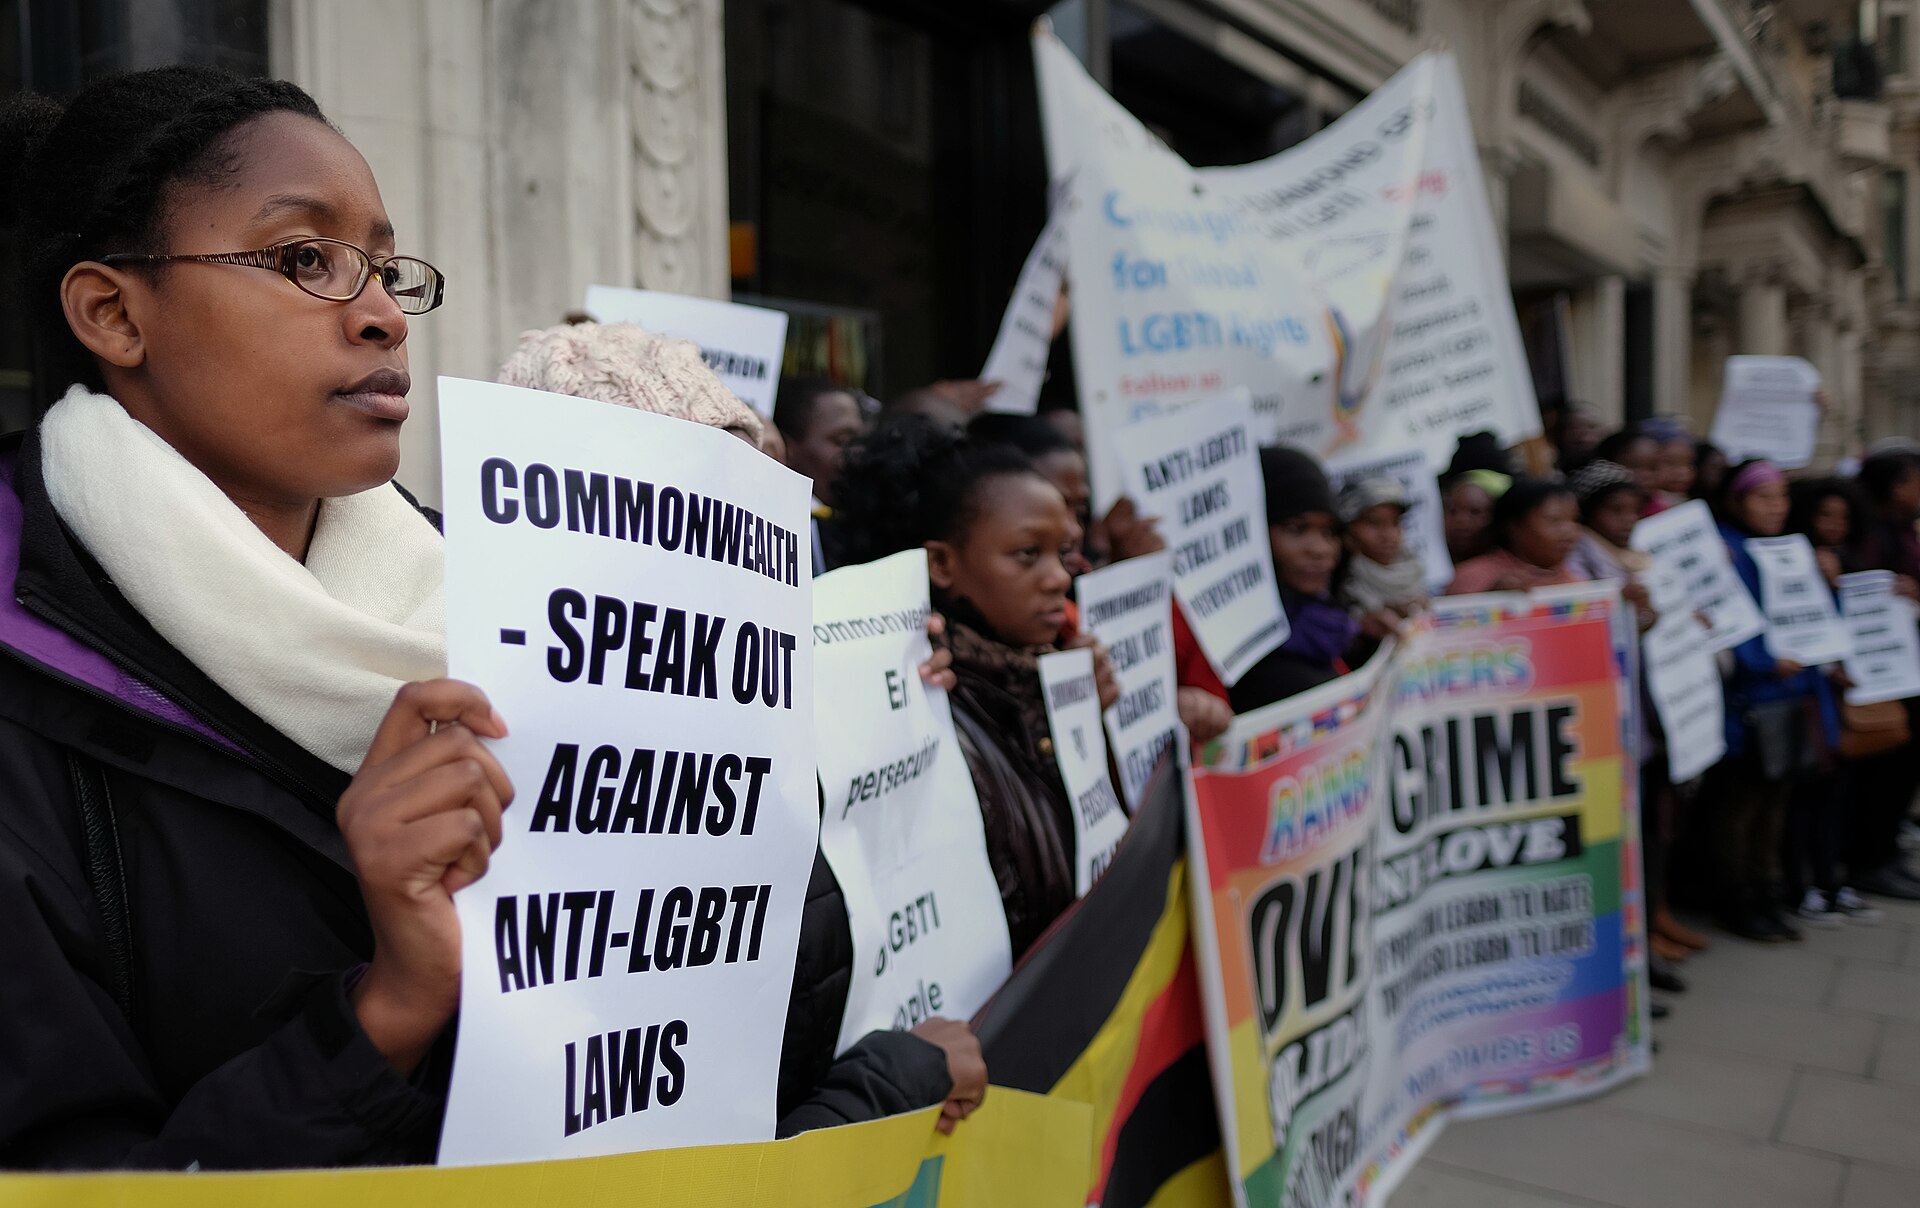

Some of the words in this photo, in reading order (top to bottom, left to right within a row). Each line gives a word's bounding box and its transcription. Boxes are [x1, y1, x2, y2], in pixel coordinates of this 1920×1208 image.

[481, 457, 799, 588] COMMONWEALTH
[1180, 478, 1230, 527] LAWS
[500, 628, 526, 646] -
[547, 587, 726, 701] SPEAK
[731, 620, 797, 710] OUT
[528, 743, 772, 837] AGAINST
[1391, 705, 1581, 835] CRIME
[495, 884, 773, 994] ANTI-LGBTI
[564, 1019, 689, 1138] LAWS
